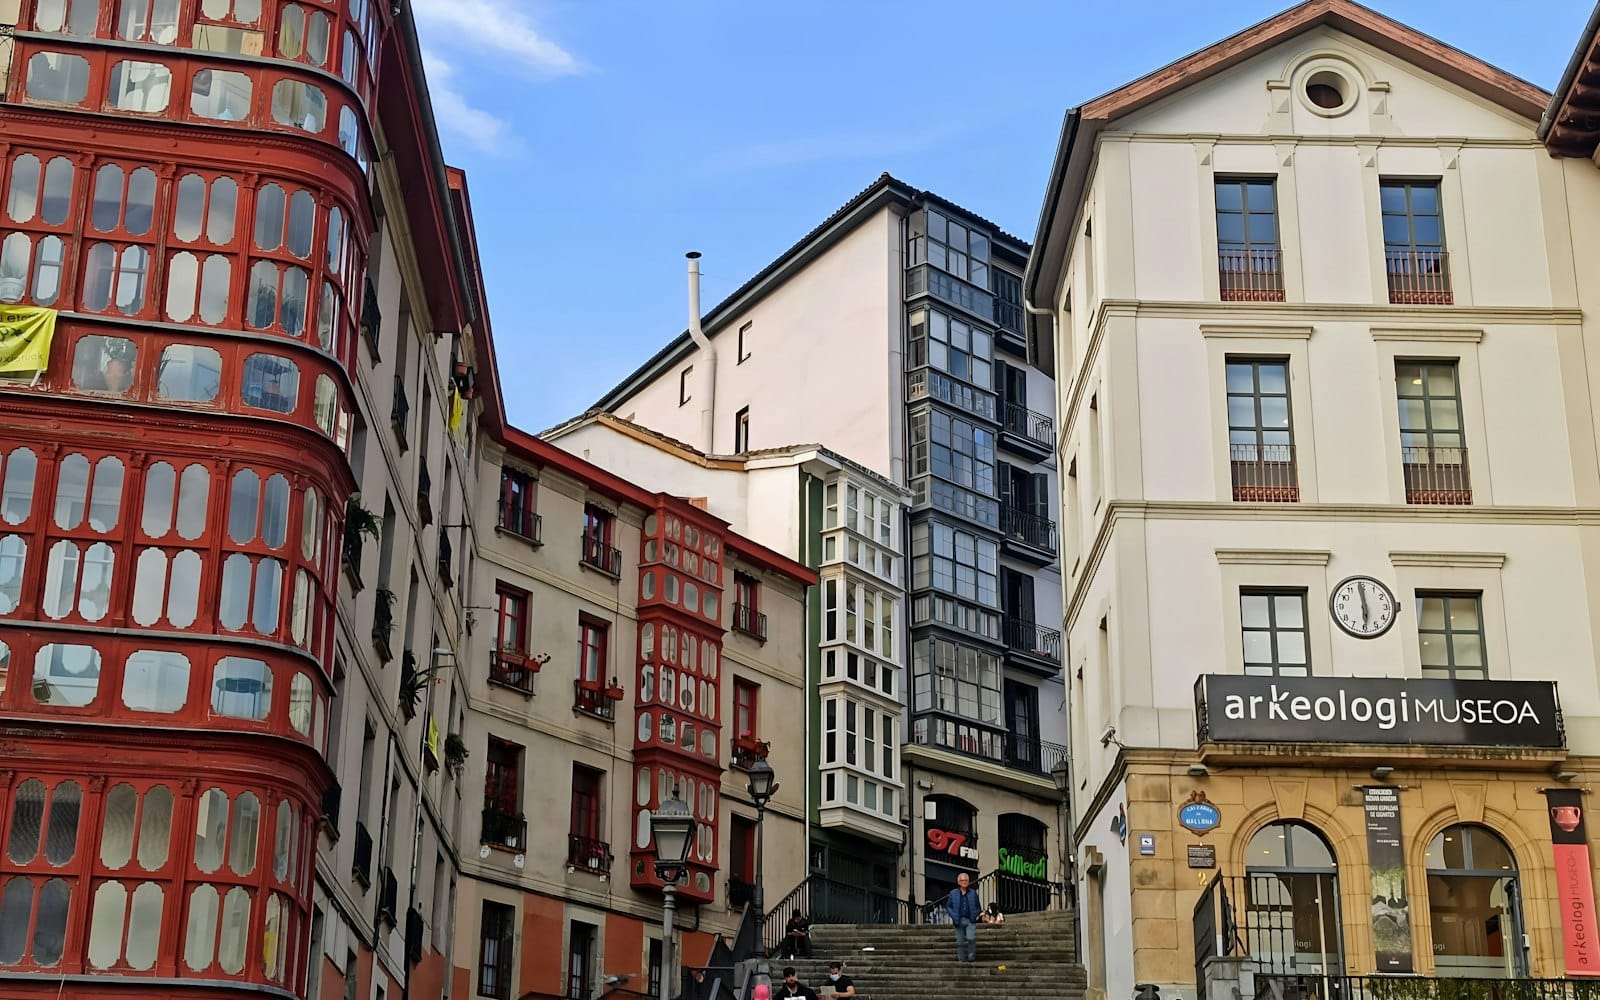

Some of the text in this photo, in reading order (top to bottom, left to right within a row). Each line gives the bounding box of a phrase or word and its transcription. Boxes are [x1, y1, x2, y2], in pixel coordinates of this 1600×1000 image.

[1351, 620, 1356, 629] 7
[1373, 621, 1379, 629] 5
[1224, 684, 1541, 730] arkeologi MUSEOA
[927, 828, 979, 860] 97 FM
[1198, 872, 1207, 886] 2
[1568, 898, 1588, 965] arkeologi
